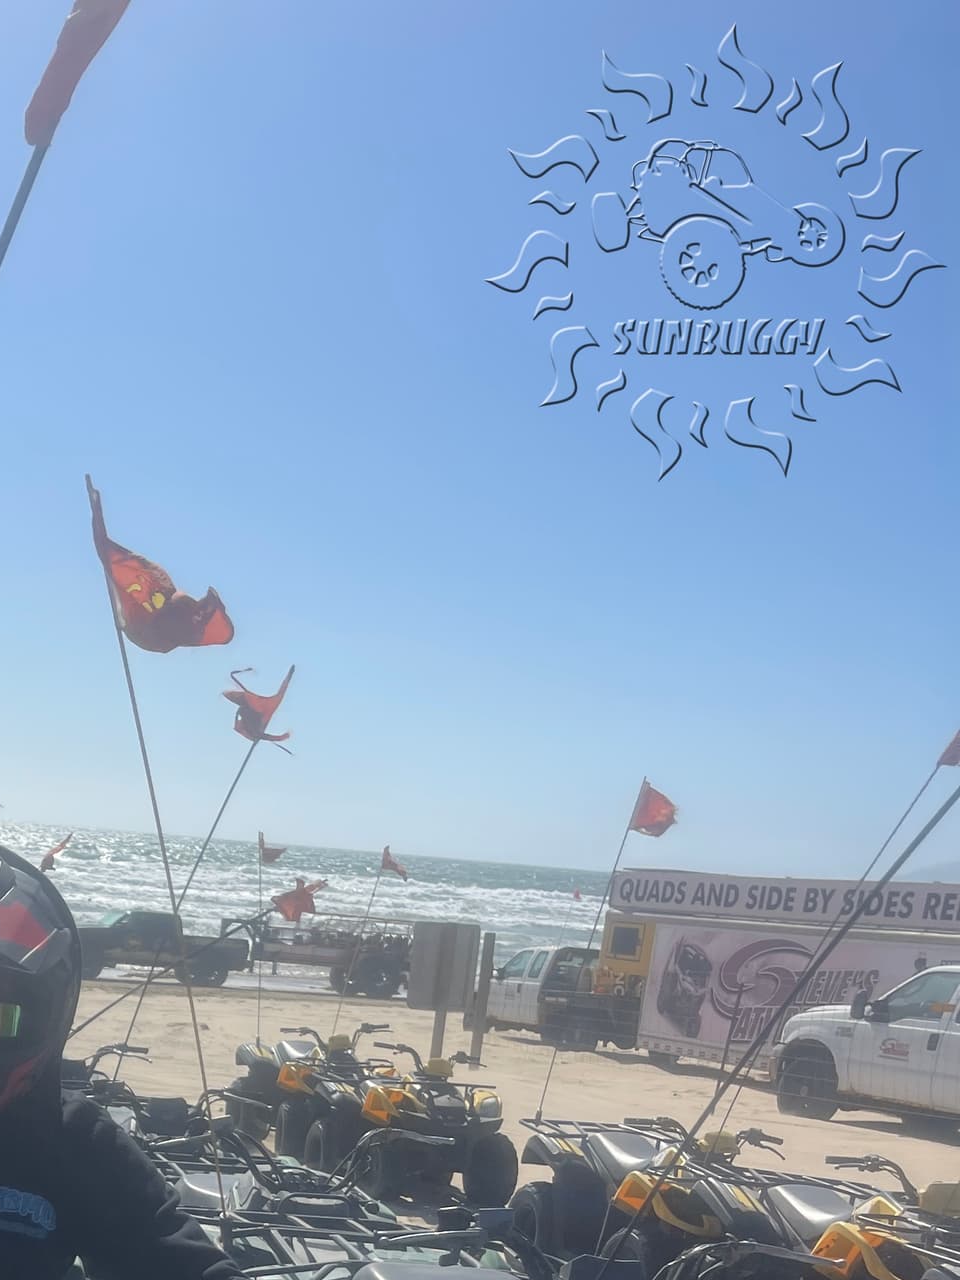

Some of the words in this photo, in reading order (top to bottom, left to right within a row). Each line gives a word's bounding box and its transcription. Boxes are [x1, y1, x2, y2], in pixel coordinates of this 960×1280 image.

[619, 878, 687, 905] QUADS
[691, 882, 740, 908] AND
[745, 885, 797, 912] SIDE
[802, 887, 837, 914] BY
[840, 888, 915, 919] SIDES
